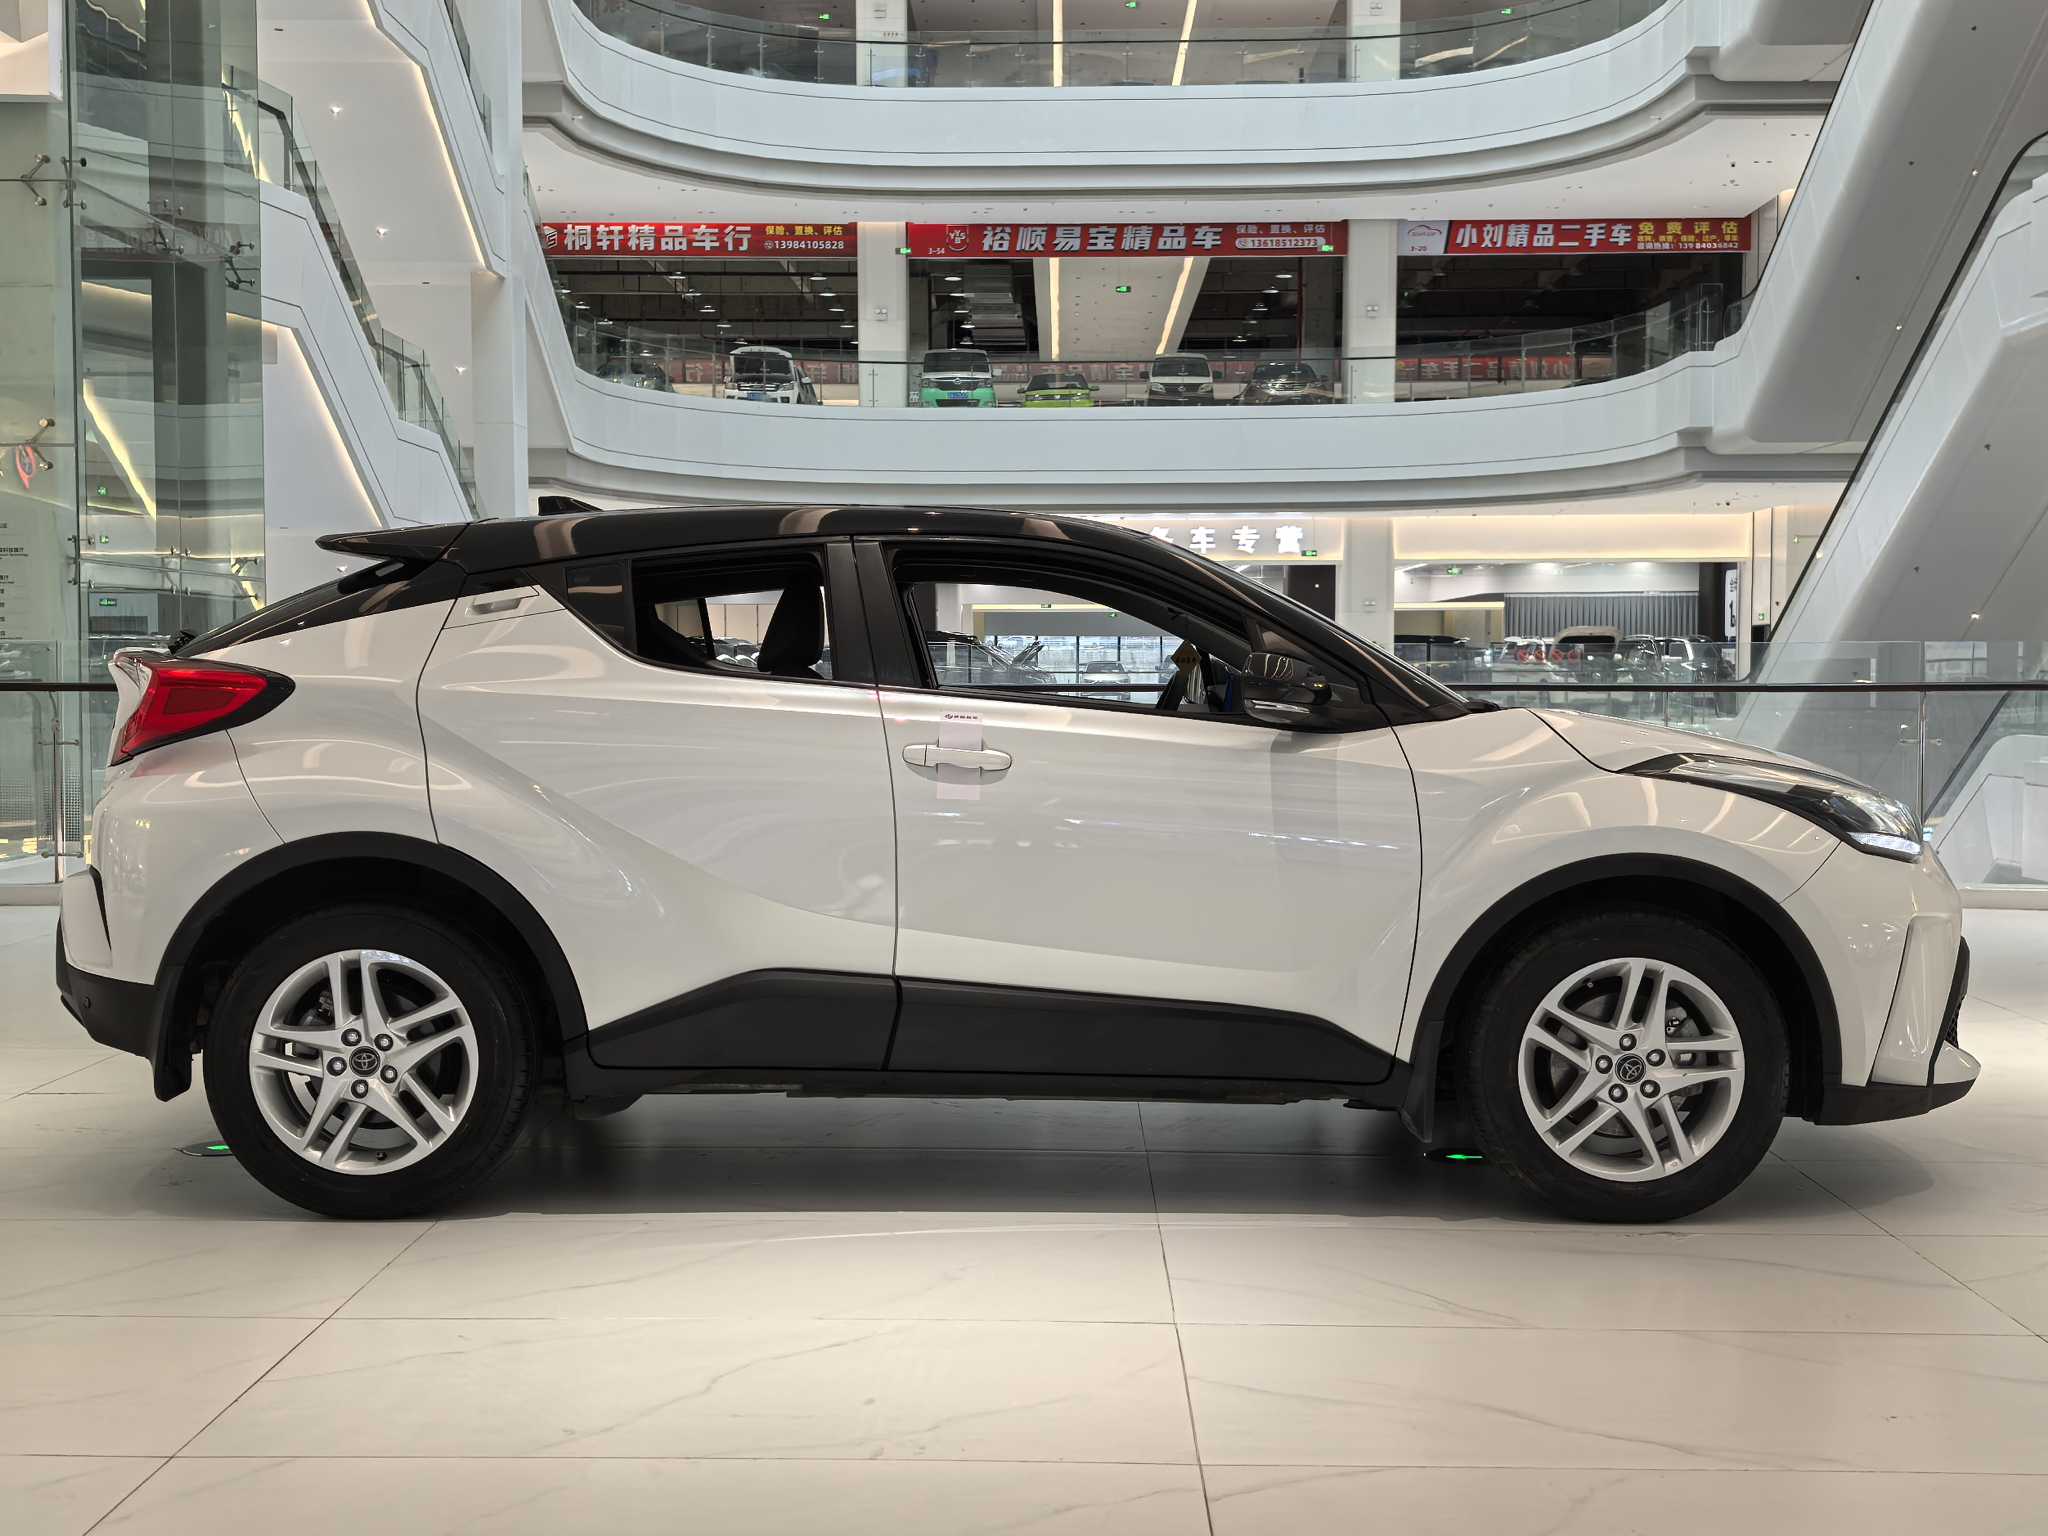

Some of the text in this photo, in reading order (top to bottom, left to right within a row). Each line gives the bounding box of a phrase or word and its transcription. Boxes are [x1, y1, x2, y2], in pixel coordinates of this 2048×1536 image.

[564, 224, 751, 251] 桐轩精品车行
[982, 225, 1223, 252] 裕顺易宝精品车
[1455, 223, 1633, 248] 小刘精品二手车
[1638, 221, 1738, 235] 免费评估
[774, 240, 844, 250] 13984105828
